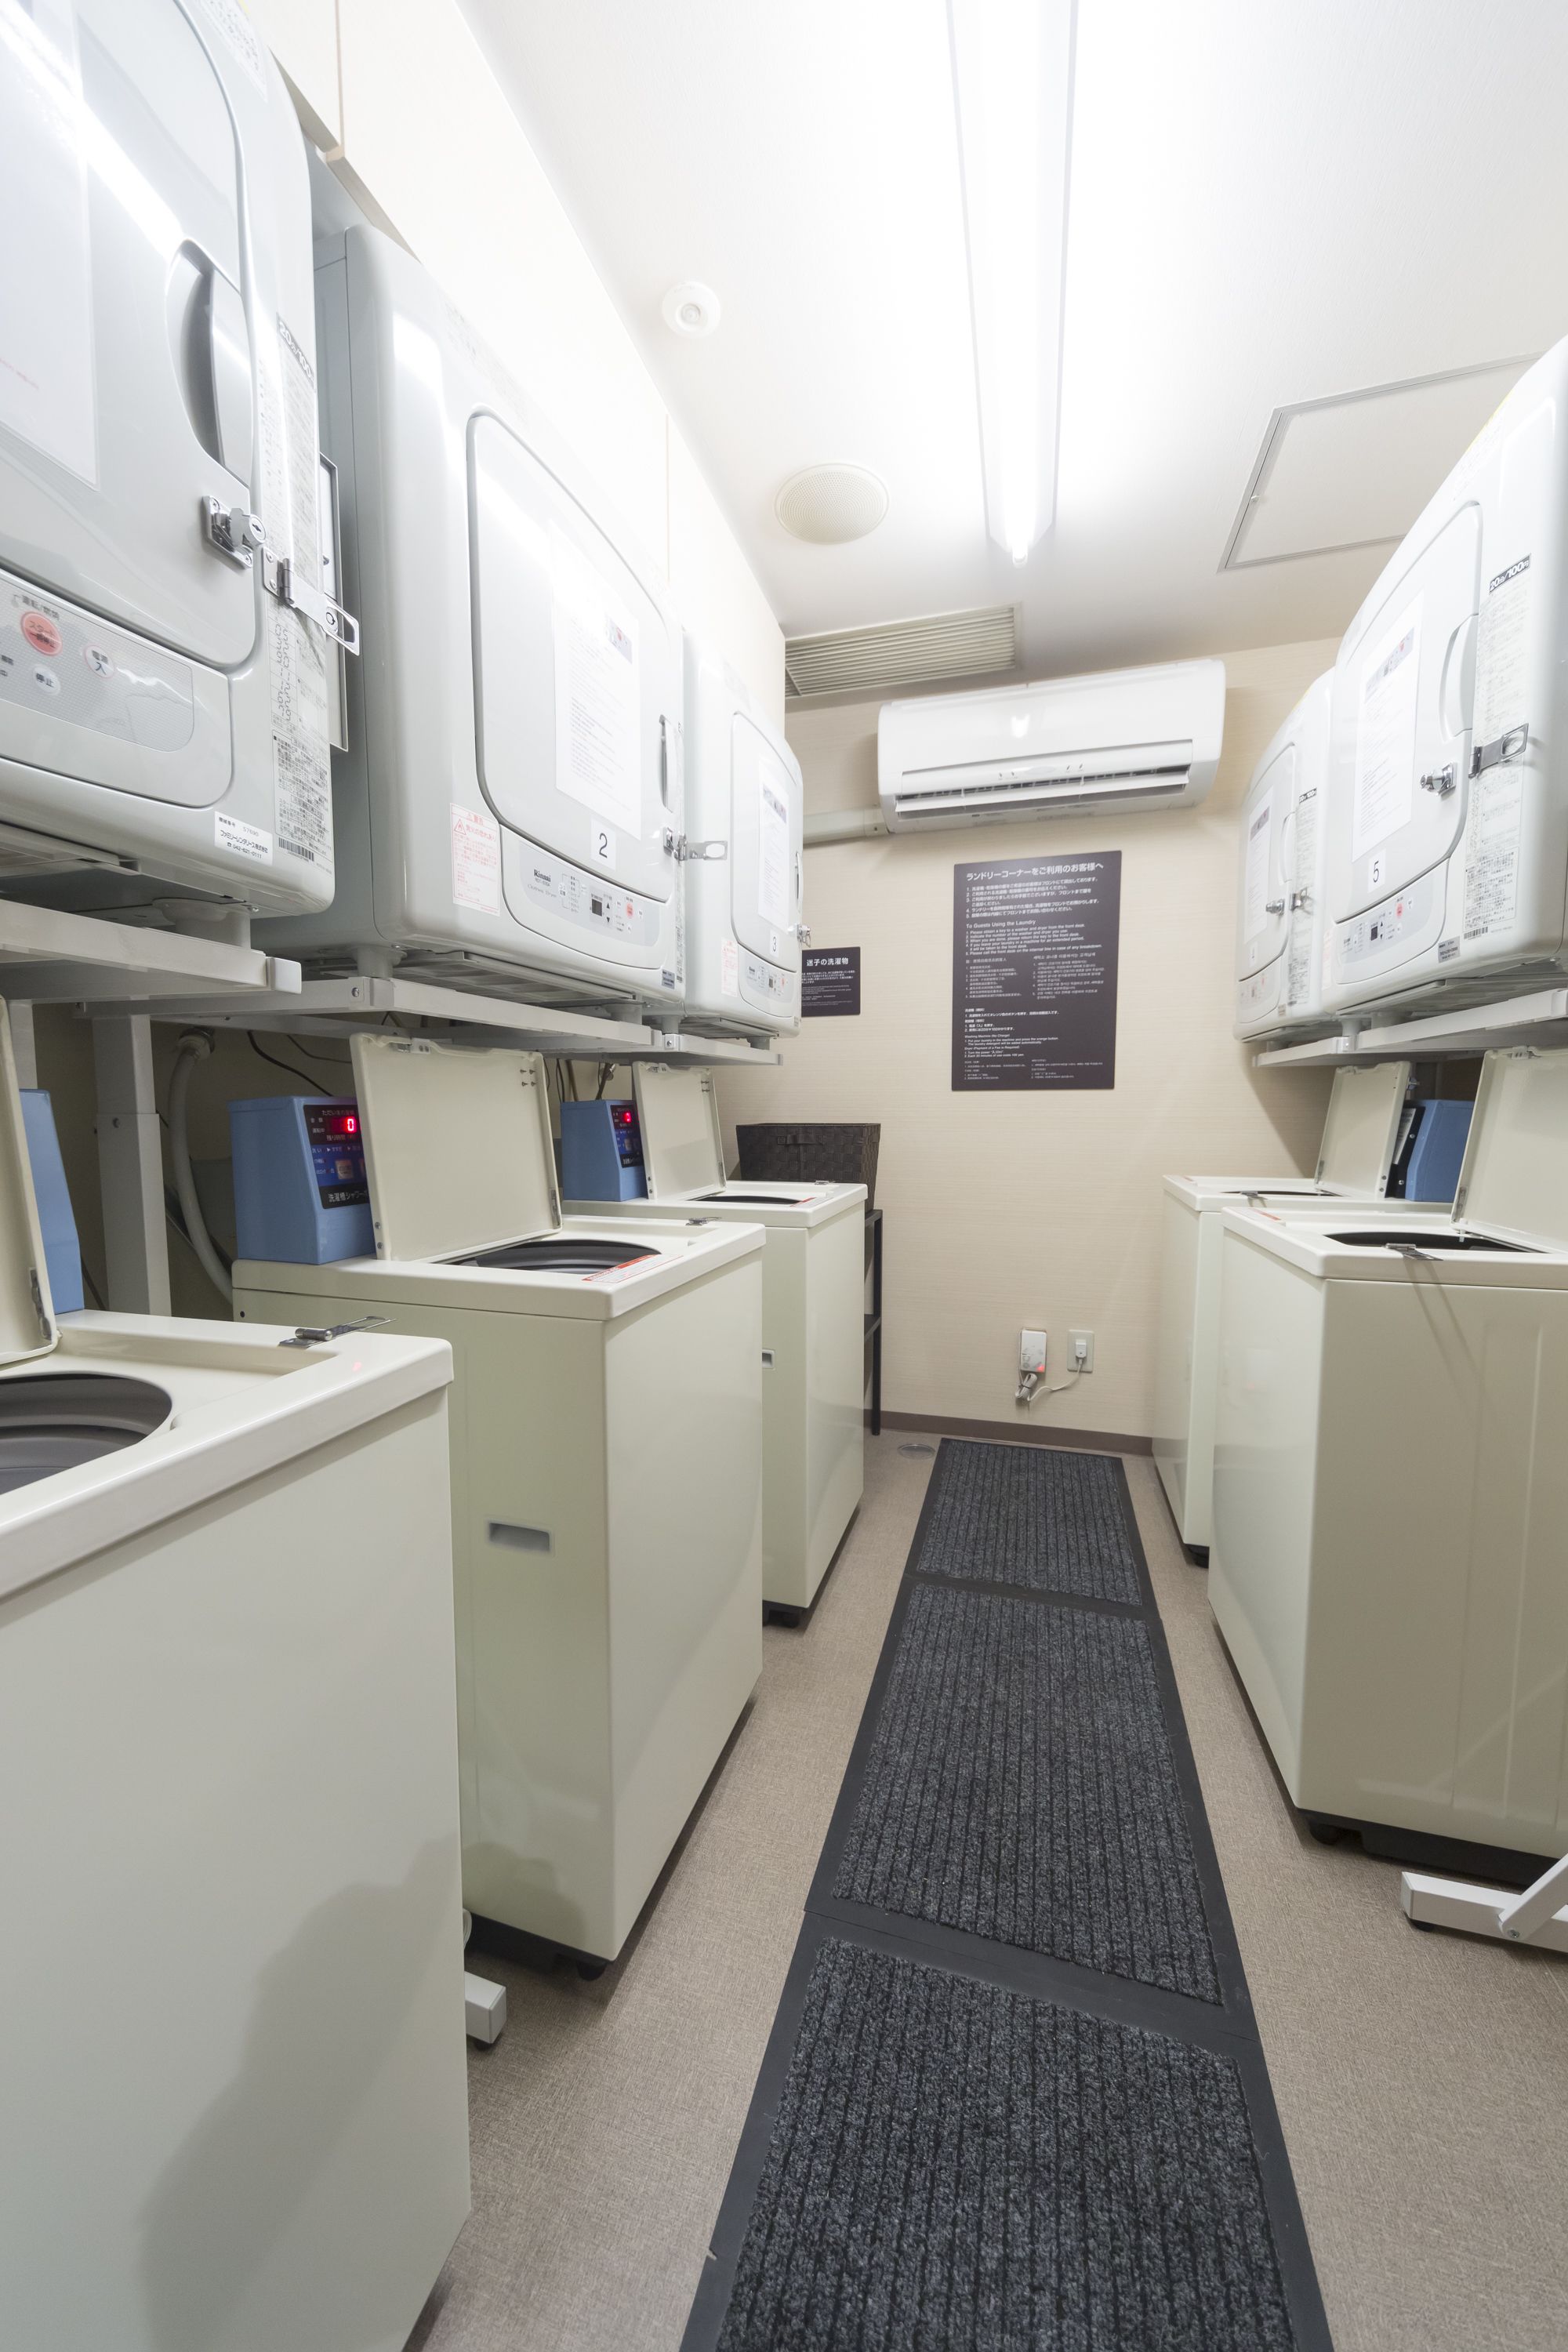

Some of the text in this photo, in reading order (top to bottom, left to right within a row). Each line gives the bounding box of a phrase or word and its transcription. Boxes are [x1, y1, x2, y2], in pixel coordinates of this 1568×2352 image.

[1490, 560, 1530, 591] 20分/100円
[95, 661, 107, 675] 入
[36, 673, 55, 688] 停止
[599, 832, 608, 858] 2
[534, 869, 551, 883] Rinnai
[967, 862, 1104, 881] ランドリーコーナーをご利用のお客様へ
[1373, 860, 1380, 883] 5
[772, 936, 777, 952] 3
[806, 957, 849, 966] 迷子の洗濯物
[347, 1118, 354, 1132] 0
